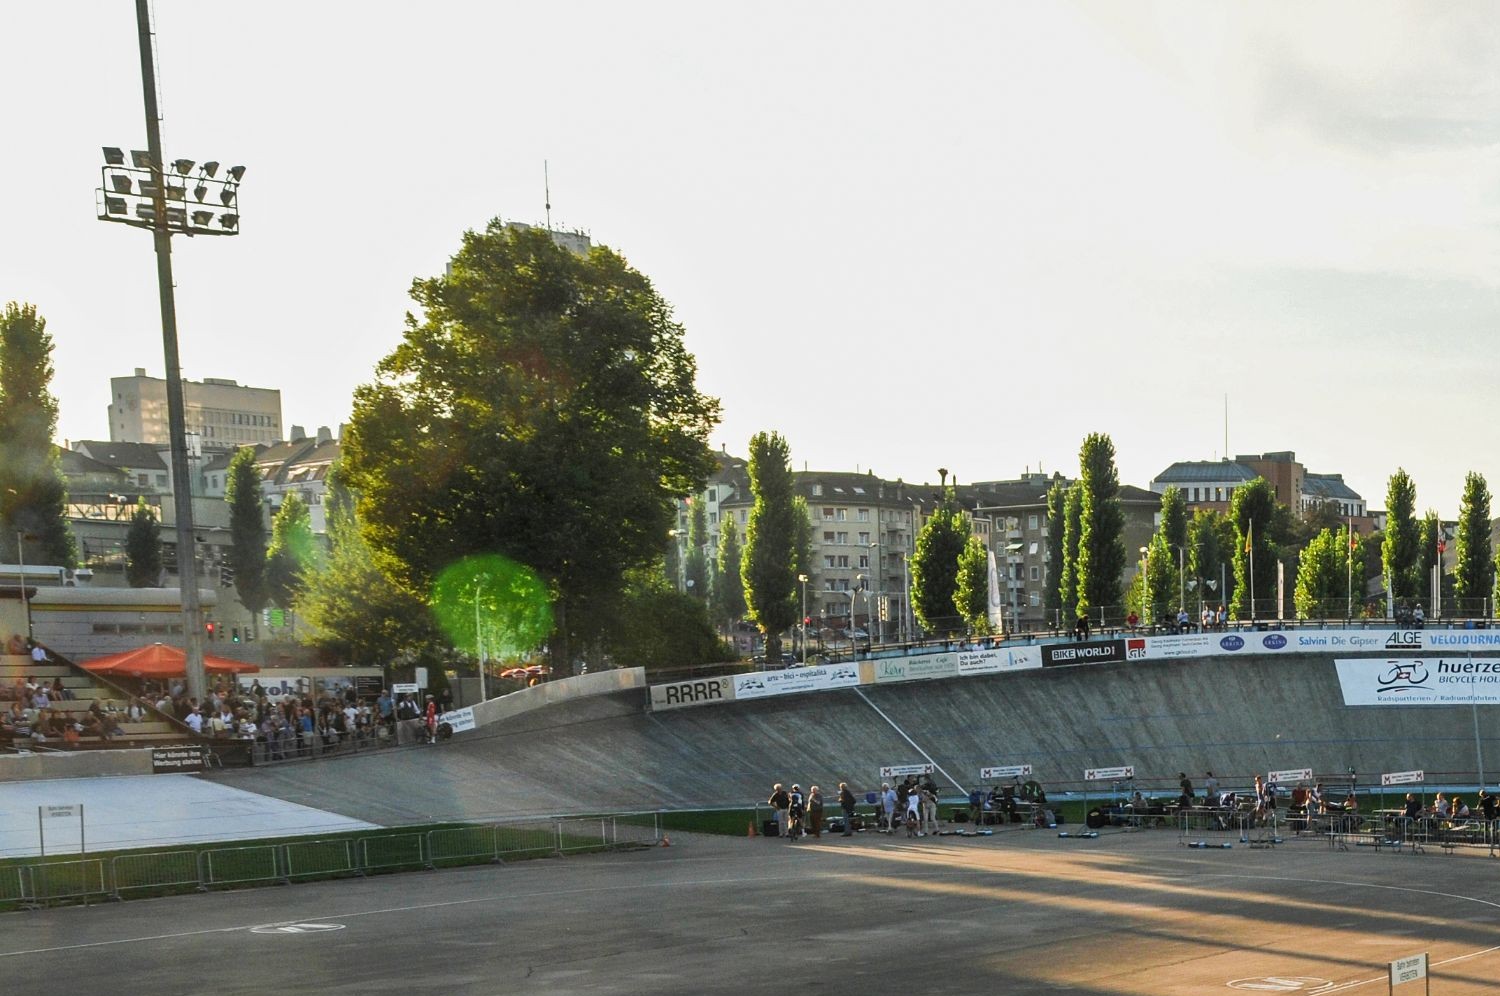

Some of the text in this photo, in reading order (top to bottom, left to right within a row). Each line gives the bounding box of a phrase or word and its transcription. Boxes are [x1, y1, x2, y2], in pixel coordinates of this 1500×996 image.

[1299, 636, 1379, 647] Salvini Die Gipser
[1386, 632, 1422, 643] ALGE
[1052, 648, 1110, 660] BIKE WORLD
[1439, 676, 1476, 684] BICYCLE
